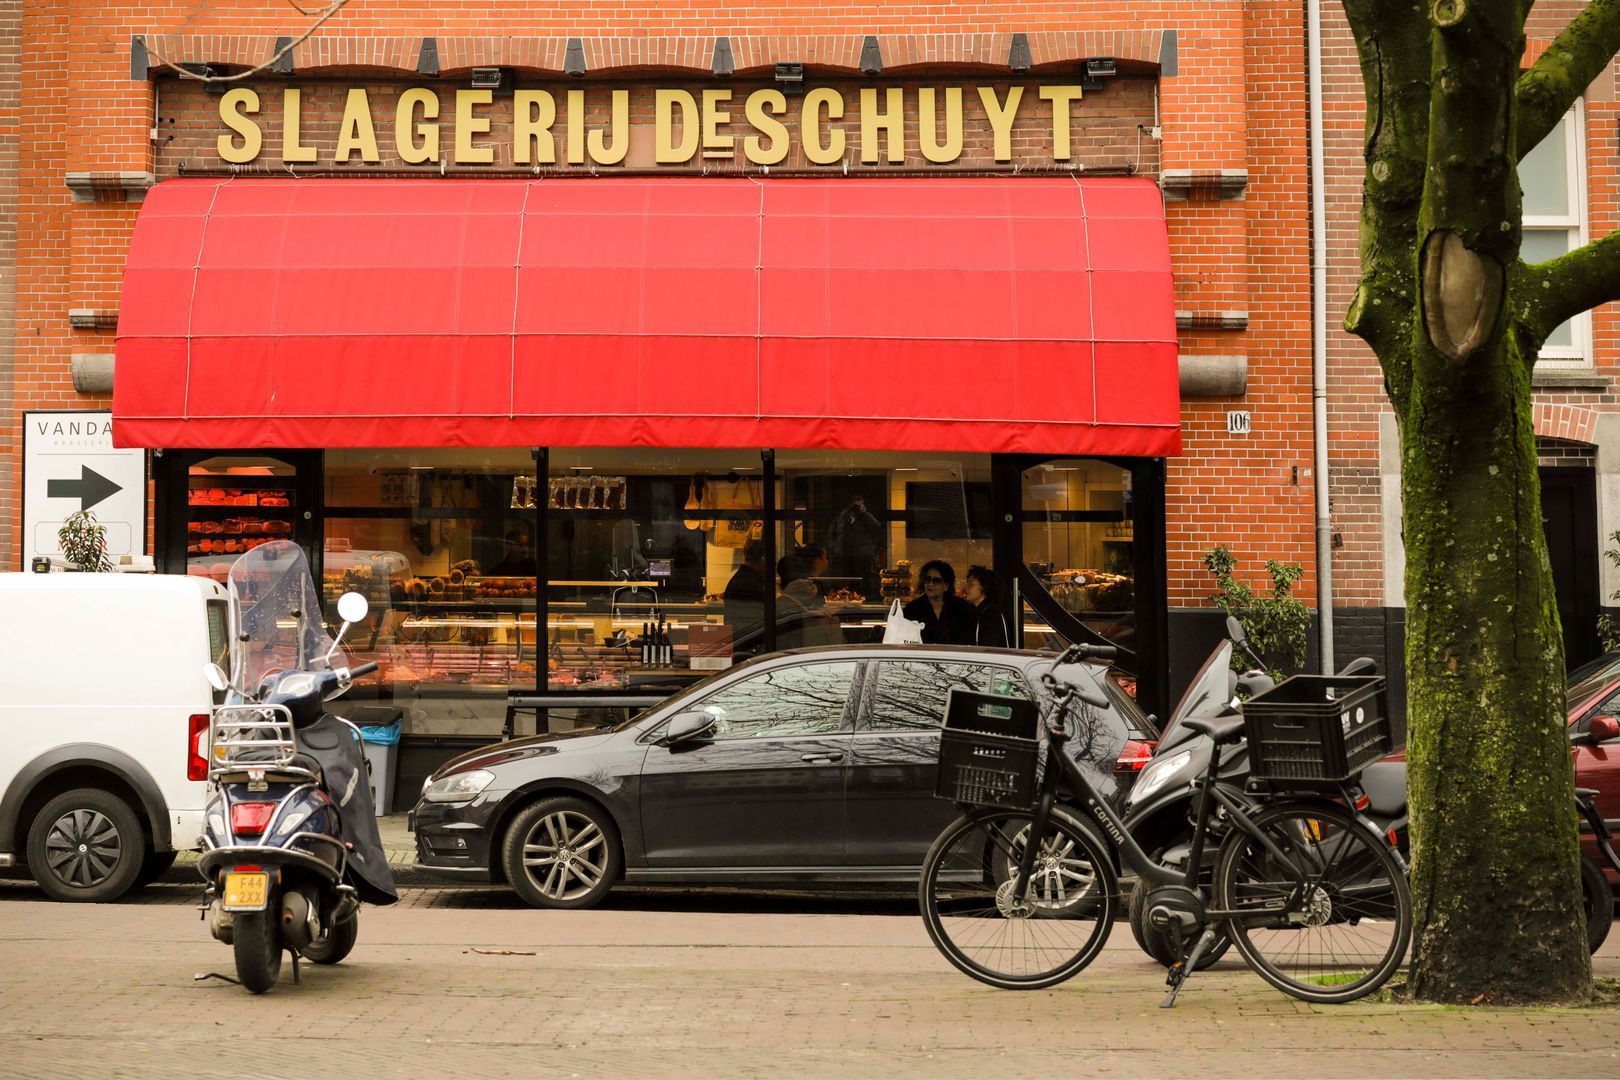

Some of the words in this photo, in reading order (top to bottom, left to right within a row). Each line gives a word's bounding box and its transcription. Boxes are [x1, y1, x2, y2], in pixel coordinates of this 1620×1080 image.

[217, 88, 629, 164] SLAGERIJ
[38, 422, 113, 436] VANDA
[1229, 413, 1250, 431] 106
[240, 877, 262, 888] F44
